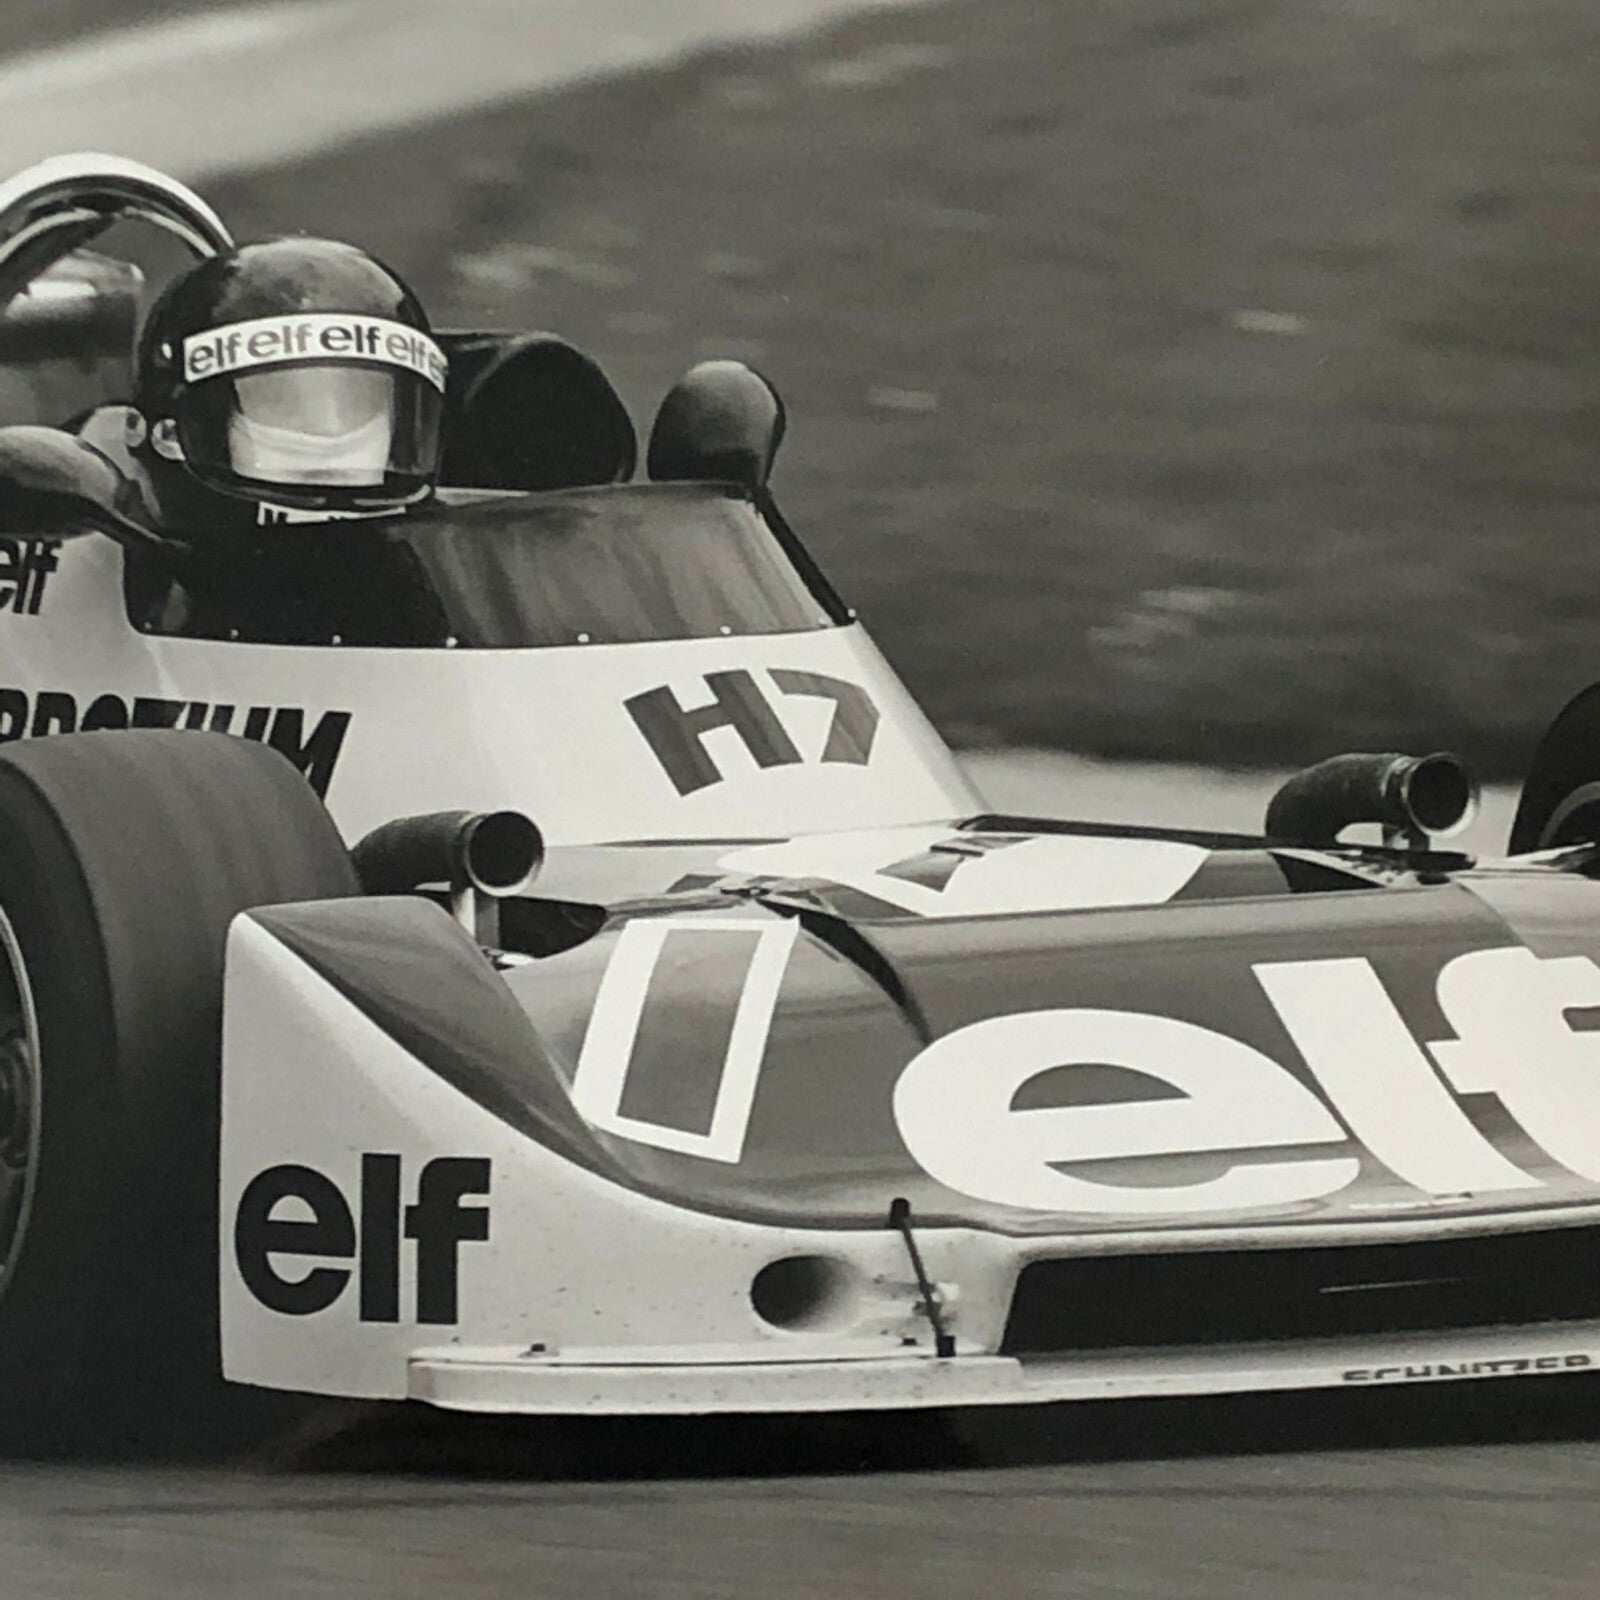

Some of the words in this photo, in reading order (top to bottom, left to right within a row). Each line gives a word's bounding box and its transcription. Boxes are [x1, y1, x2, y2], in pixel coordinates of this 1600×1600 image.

[189, 332, 242, 374] elf
[248, 323, 312, 358] elf
[319, 324, 381, 354] elf
[622, 668, 881, 797] H7
[893, 945, 1600, 1213] elf
[235, 1153, 491, 1325] elf
